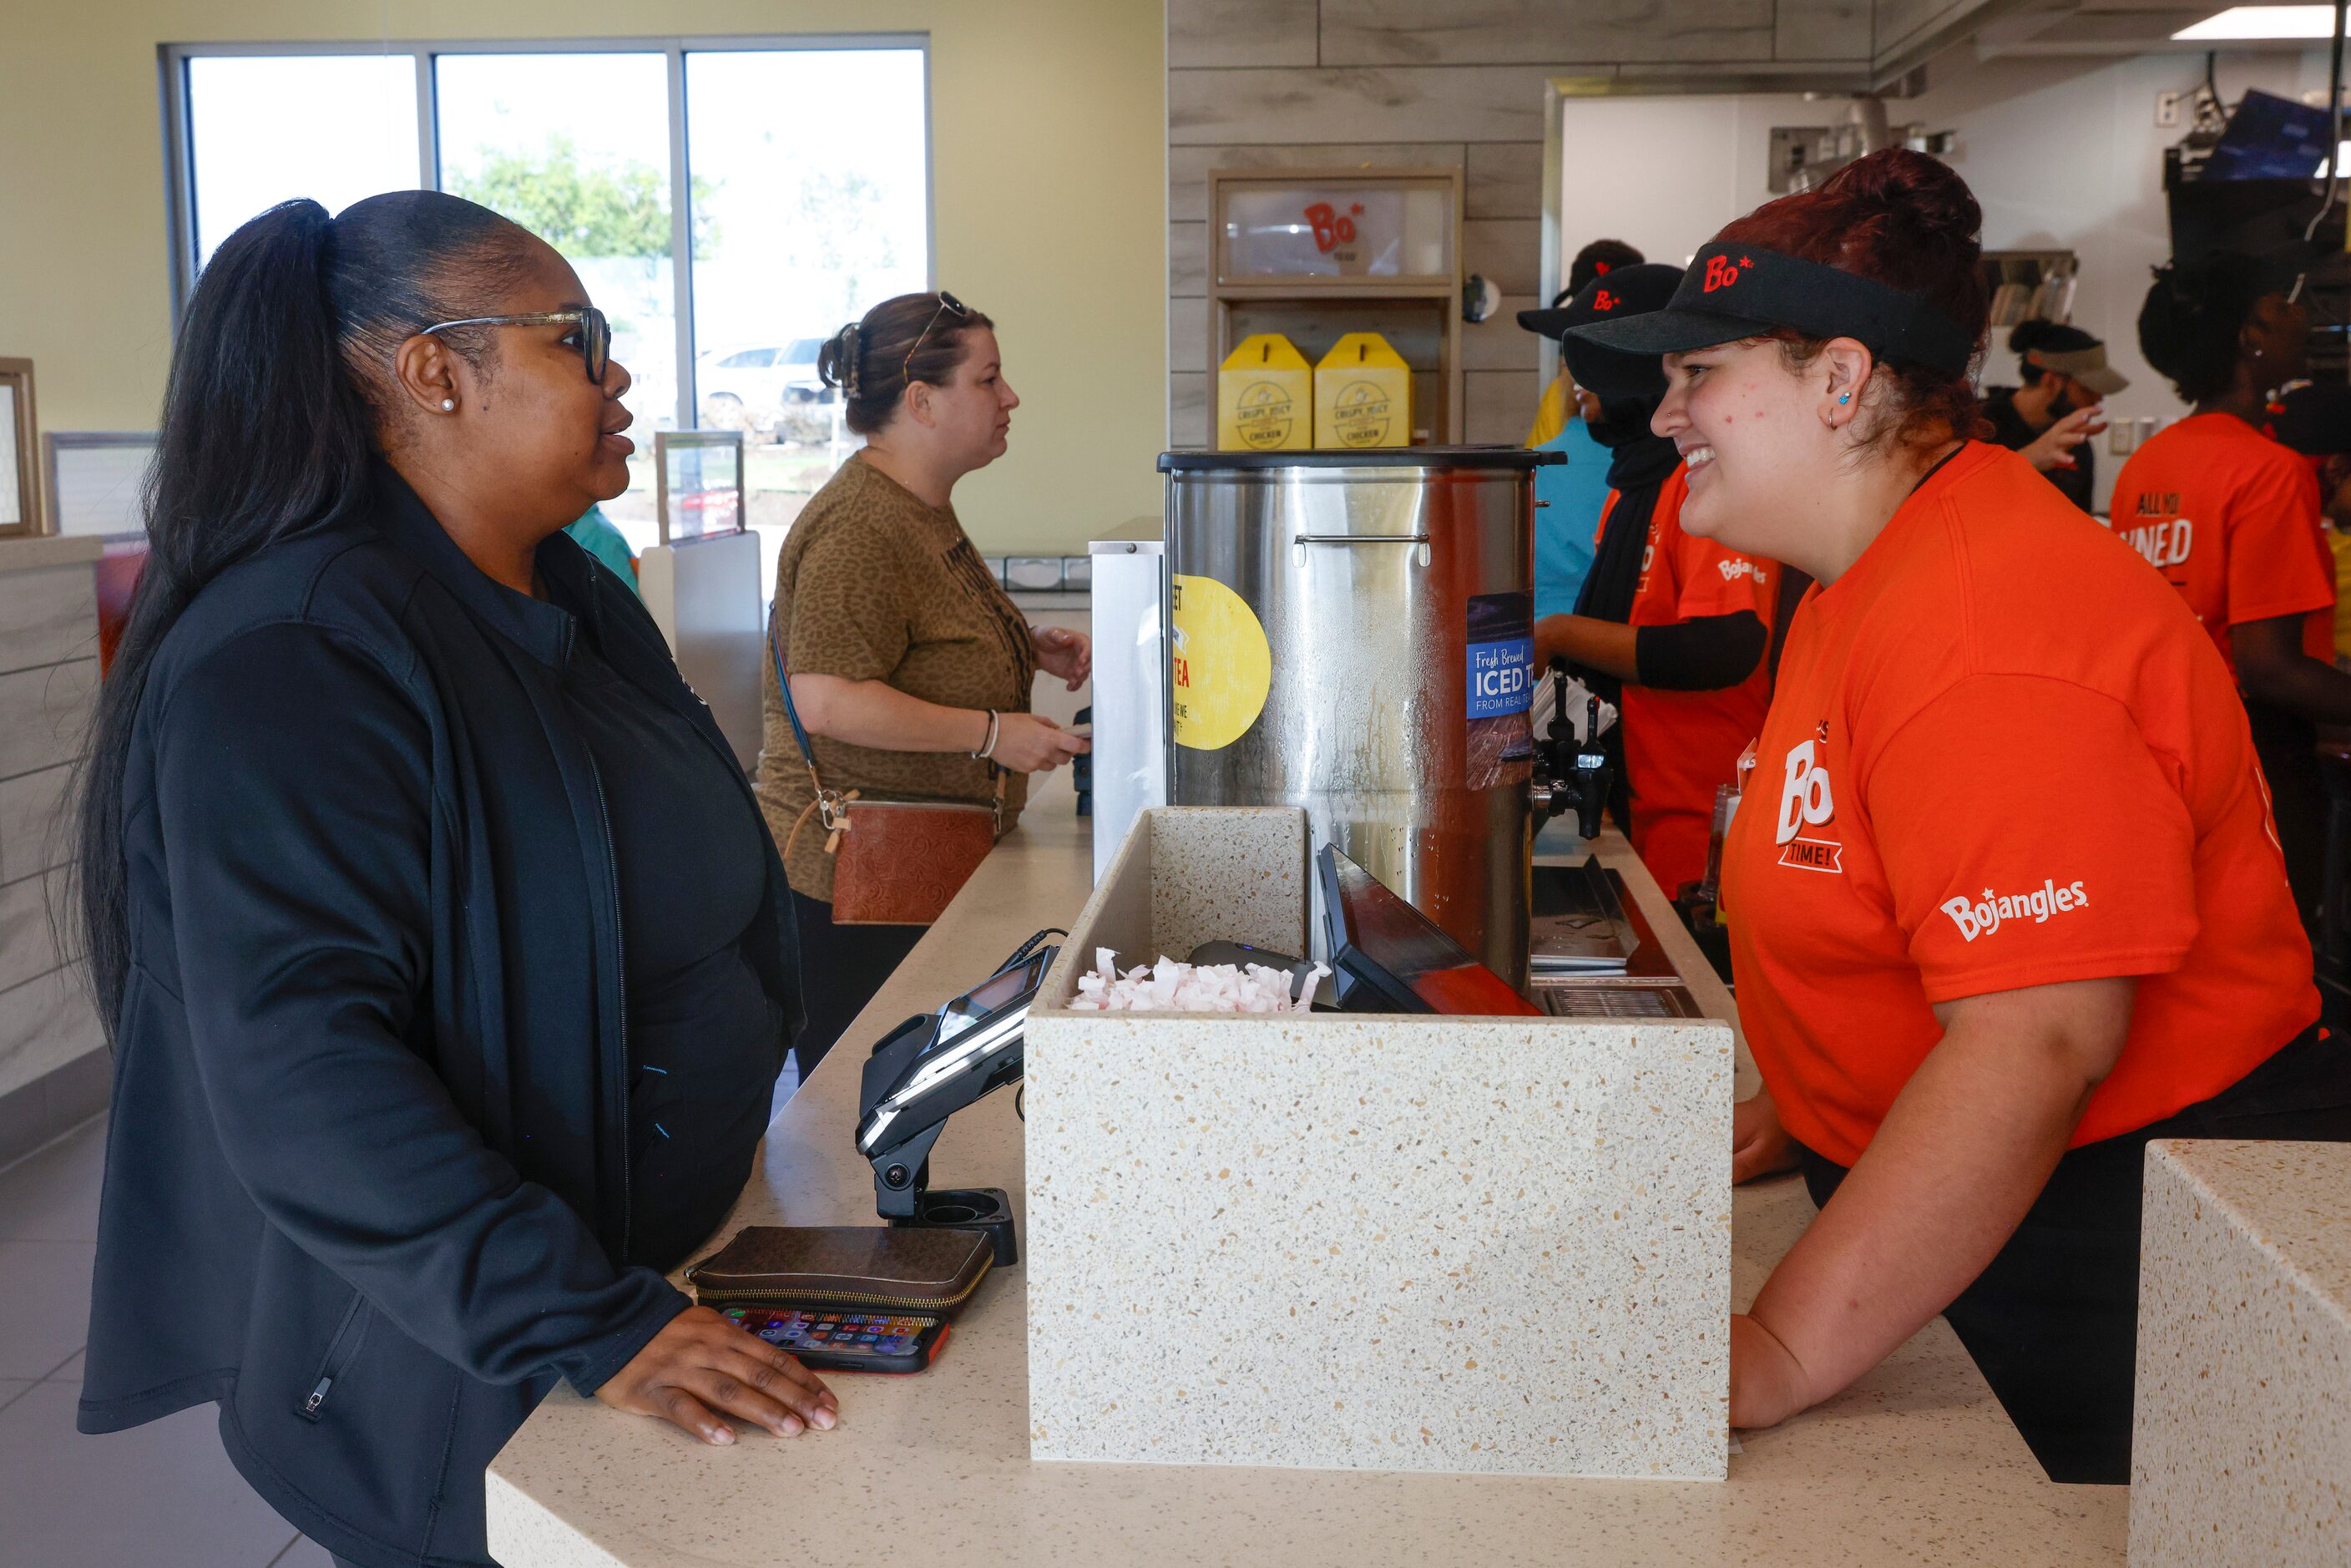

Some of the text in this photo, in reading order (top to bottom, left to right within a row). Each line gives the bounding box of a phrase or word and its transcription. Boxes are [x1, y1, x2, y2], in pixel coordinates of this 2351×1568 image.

[1303, 202, 1356, 255] Bo
[1703, 254, 1739, 293] Bo
[1593, 290, 1613, 311] Bo
[1249, 430, 1282, 442] CHICKEN
[1346, 429, 1379, 442] CHICKEN
[1475, 645, 1524, 669] Fresh Brewed
[1173, 657, 1190, 688] TEA
[1476, 667, 1524, 697] ICED
[1476, 696, 1504, 711] FROM
[1505, 695, 1522, 708] REAL
[1789, 842, 1832, 867] TIME!
[1939, 878, 2088, 943] Bojangles
